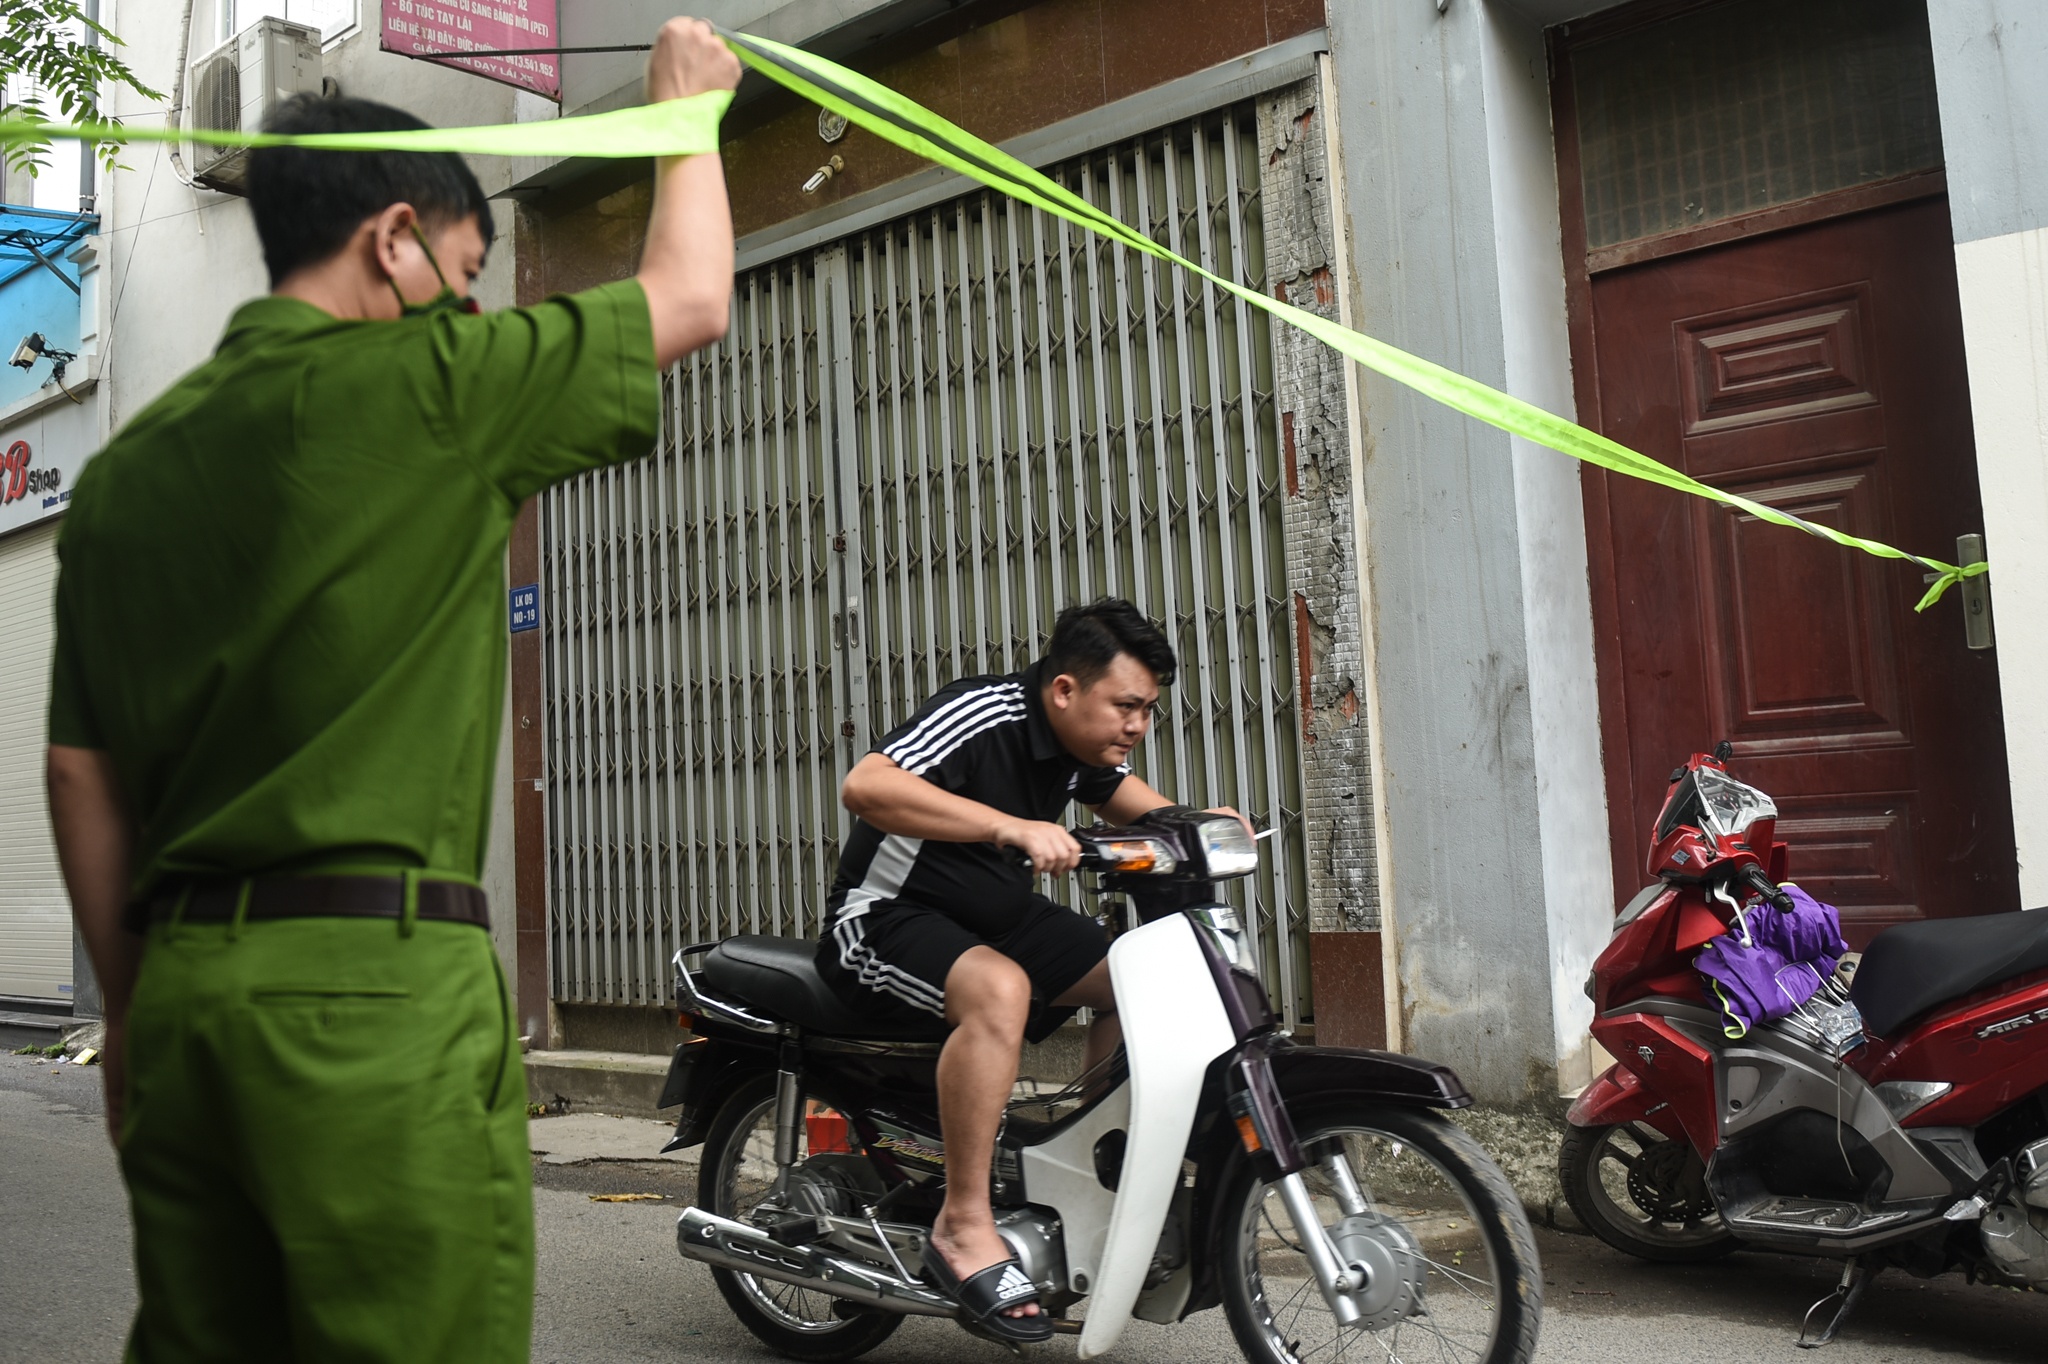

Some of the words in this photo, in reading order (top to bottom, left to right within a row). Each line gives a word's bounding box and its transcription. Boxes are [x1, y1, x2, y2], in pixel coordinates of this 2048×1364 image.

[436, 9, 455, 26] TAY
[471, 1, 492, 19] SANG
[388, 16, 407, 34] LIÊN
[0, 440, 32, 505] B
[515, 594, 524, 608] LK
[524, 592, 533, 606] 09
